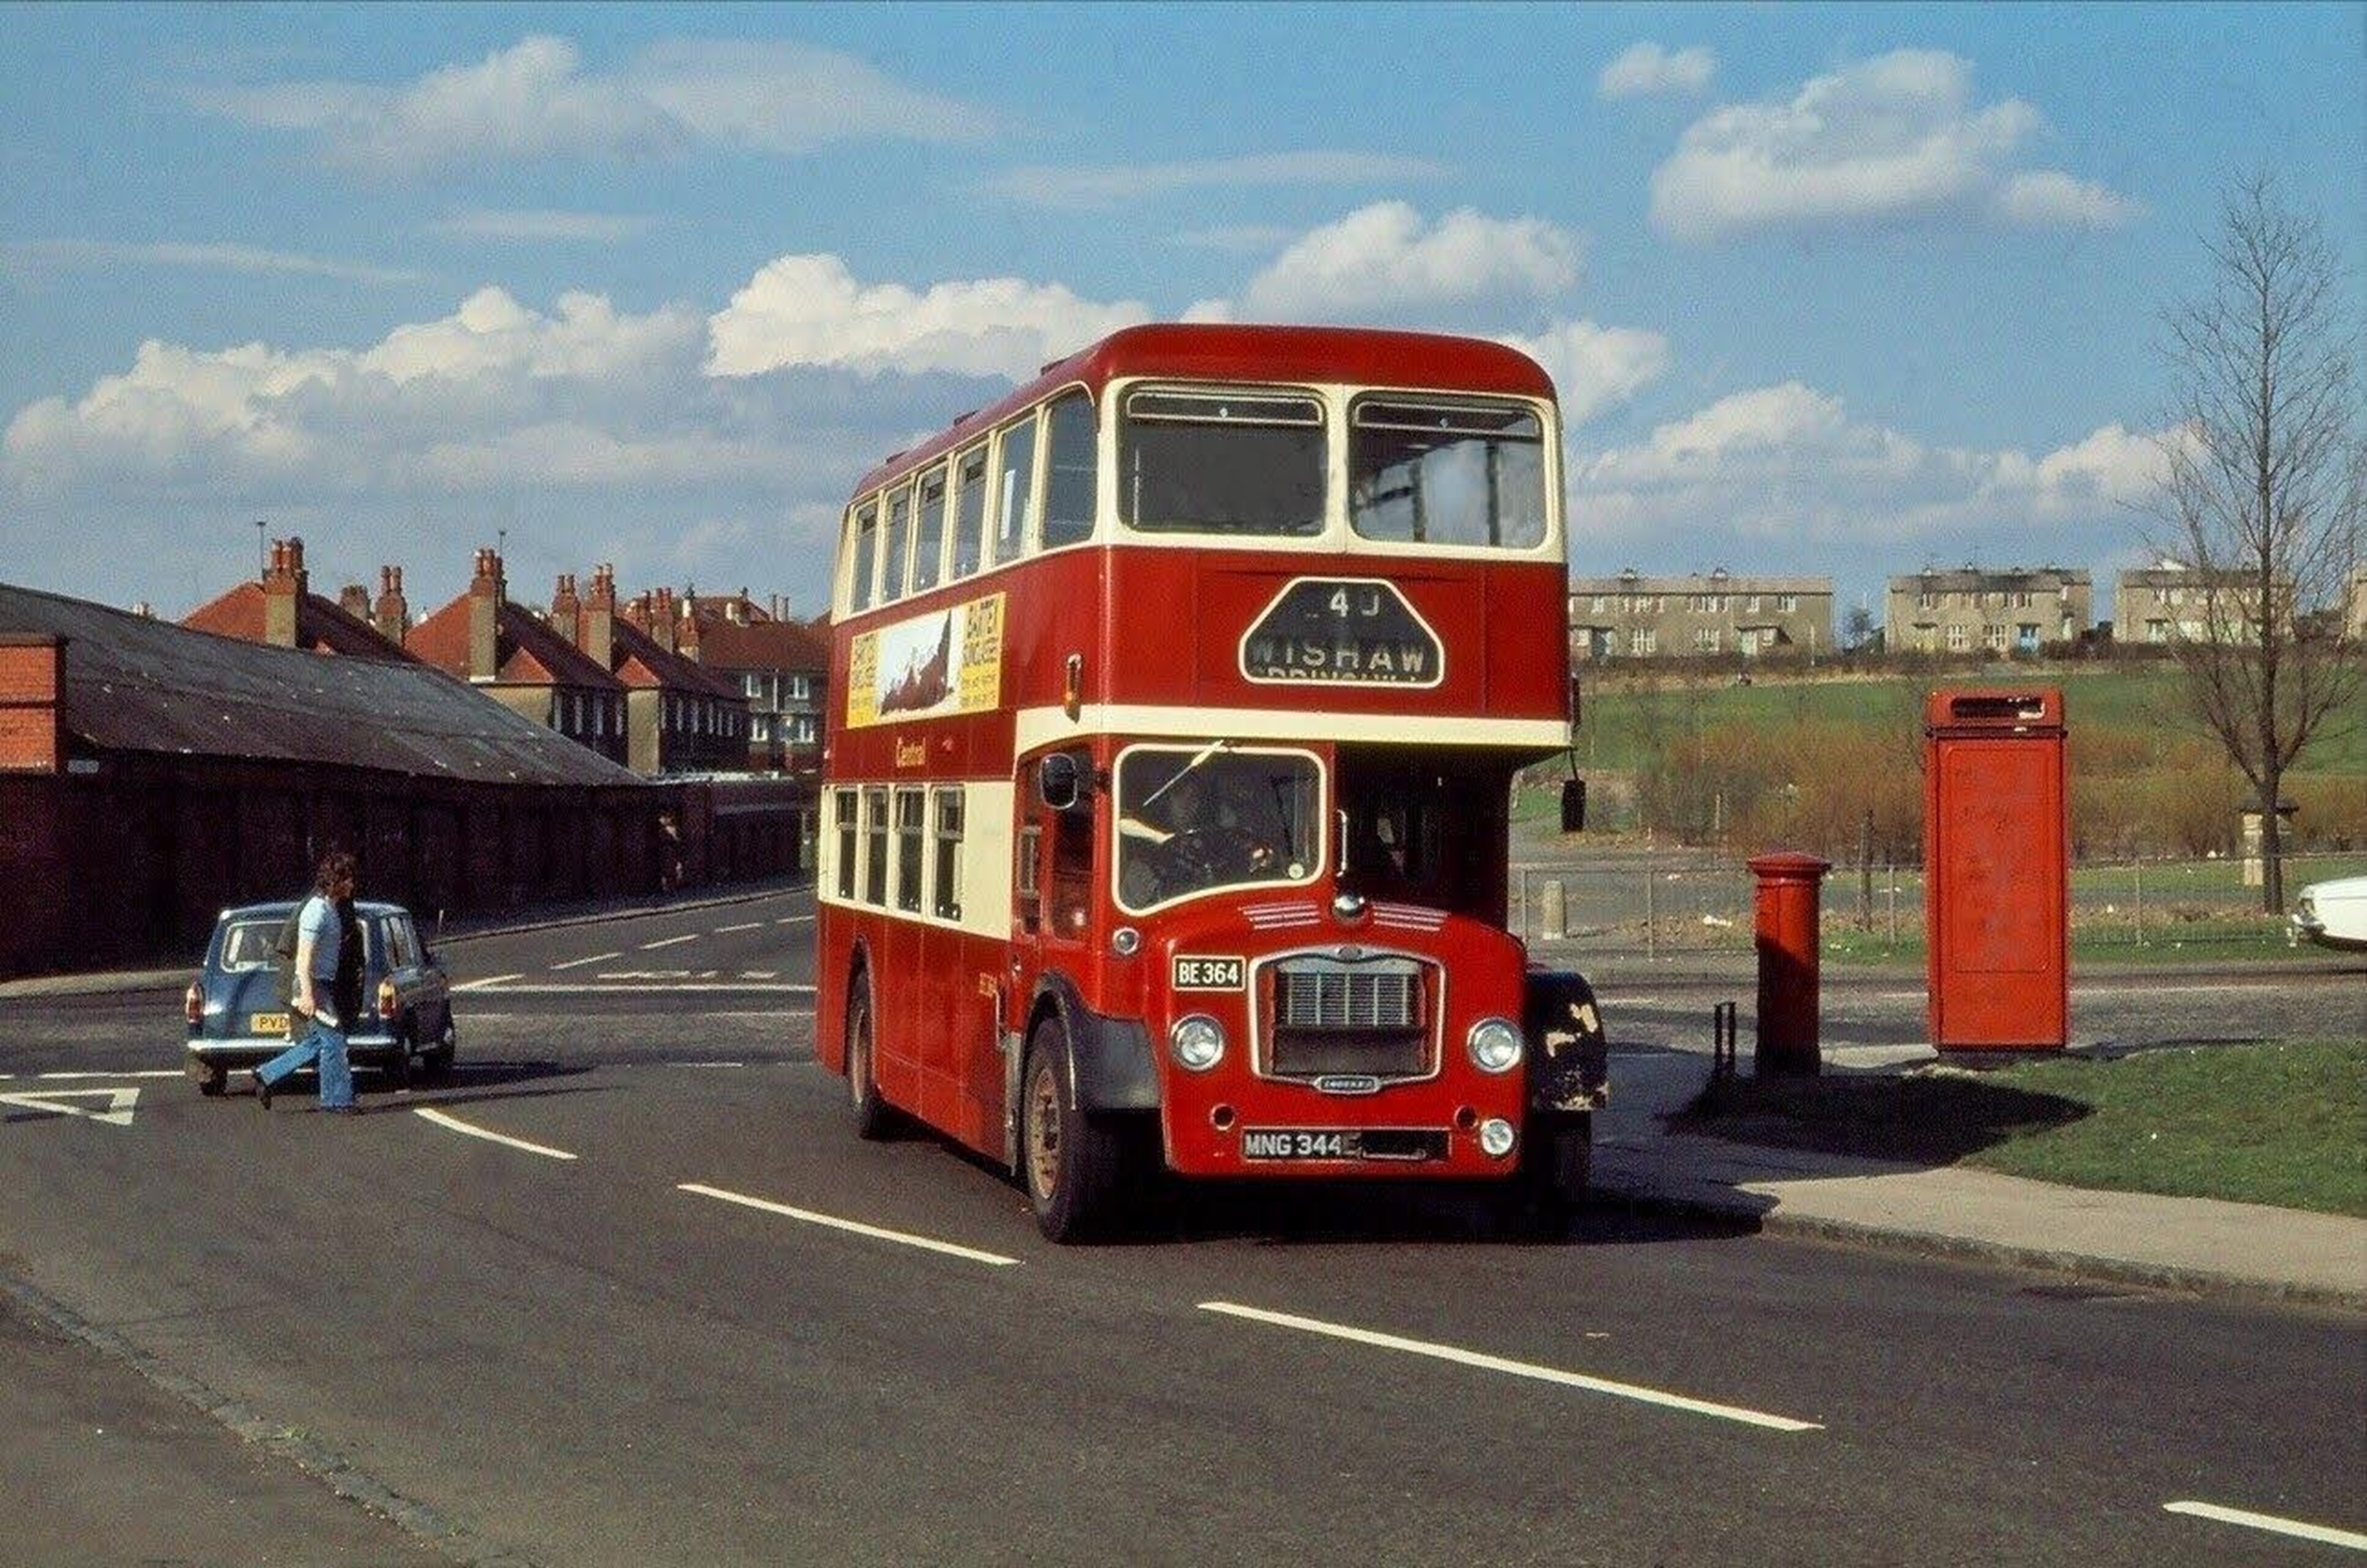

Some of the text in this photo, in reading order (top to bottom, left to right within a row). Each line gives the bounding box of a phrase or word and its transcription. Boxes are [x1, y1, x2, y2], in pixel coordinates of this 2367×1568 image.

[1251, 642, 1425, 672] WISHAW
[1178, 962, 1239, 984] BE 364
[1246, 1134, 1291, 1155] MNG
